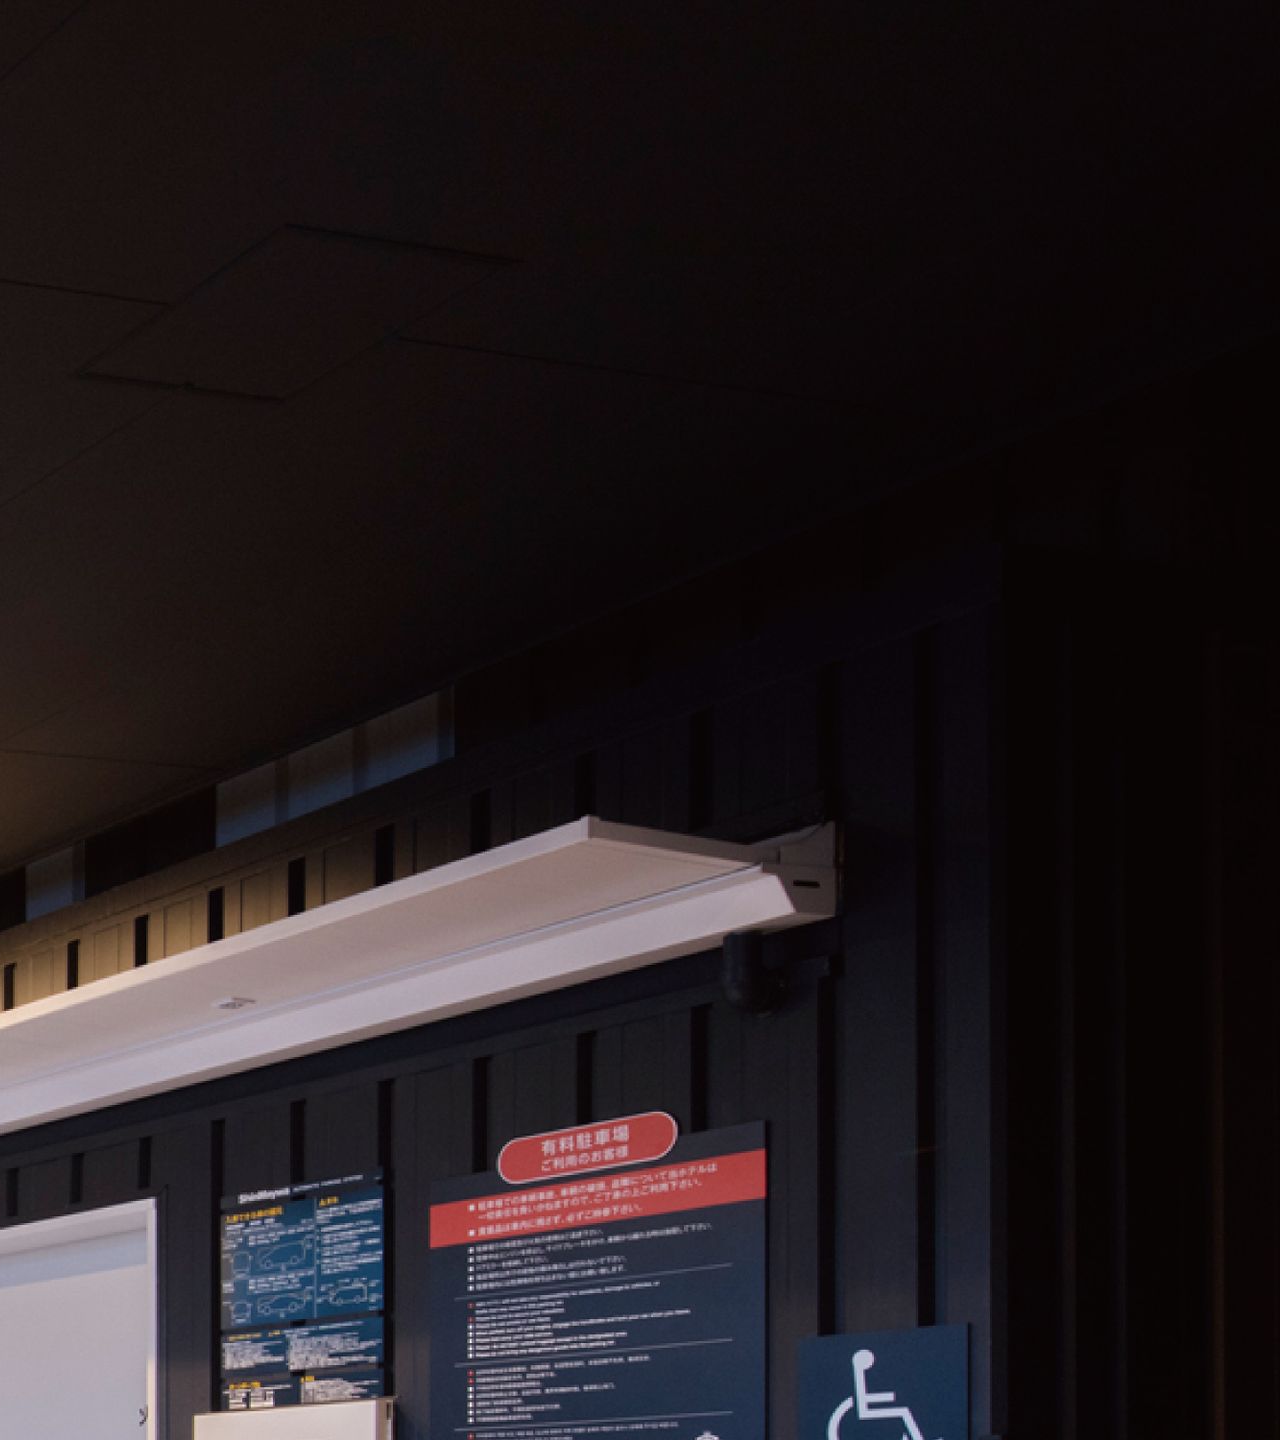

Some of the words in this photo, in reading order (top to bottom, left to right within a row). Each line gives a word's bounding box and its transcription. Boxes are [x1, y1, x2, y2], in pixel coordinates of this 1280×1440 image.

[541, 1124, 630, 1157] 有料駐車場
[541, 1144, 629, 1172] ご利用のお客様
